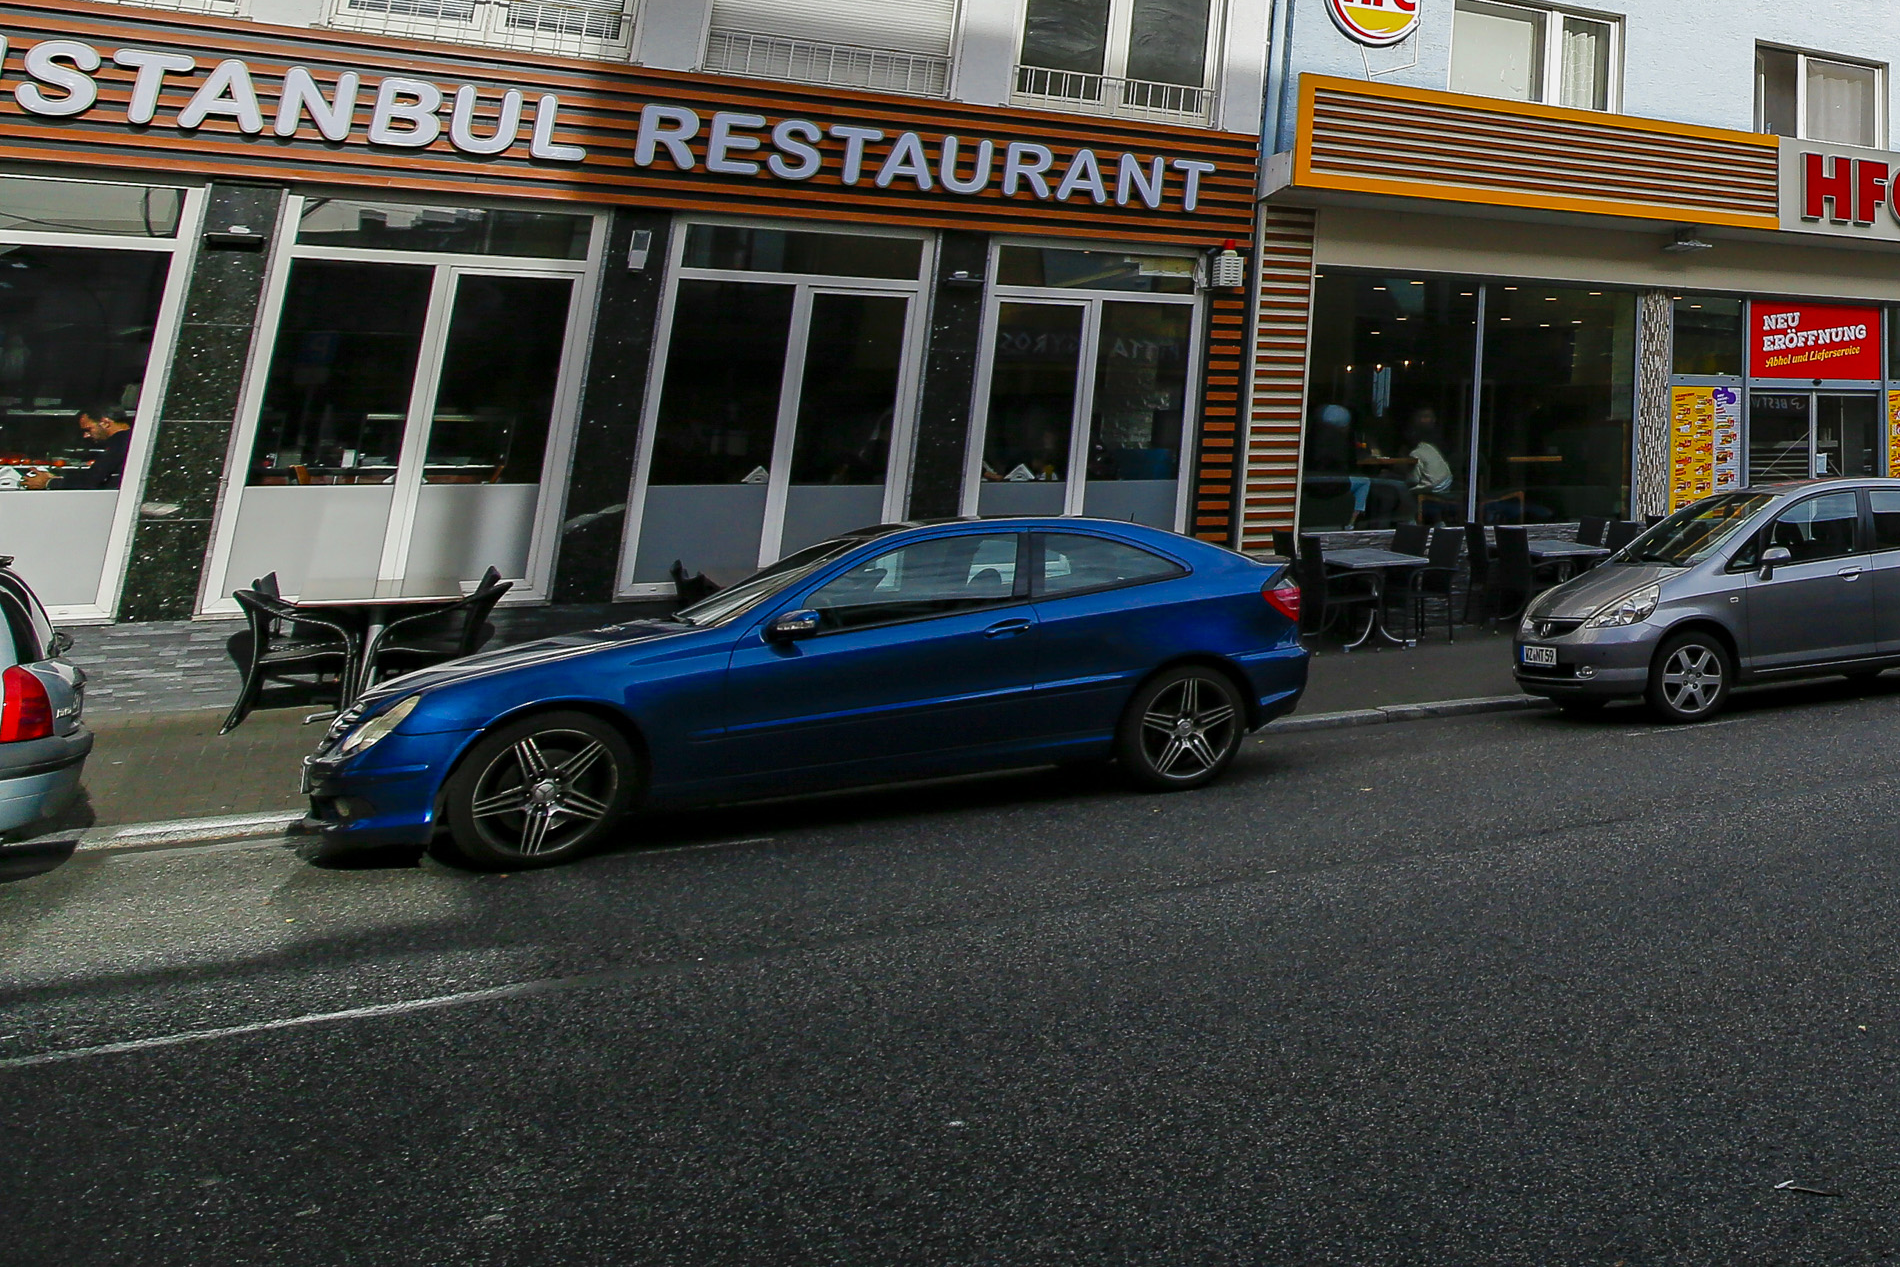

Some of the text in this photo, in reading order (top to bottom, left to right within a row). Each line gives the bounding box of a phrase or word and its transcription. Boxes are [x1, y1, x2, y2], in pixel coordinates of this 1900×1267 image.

[634, 102, 1217, 213] RESTAURANT
[1763, 312, 1801, 331] NEU
[1762, 324, 1867, 352] ERÖFFNUNG
[1765, 345, 1861, 368] Abhol und Lieferservice
